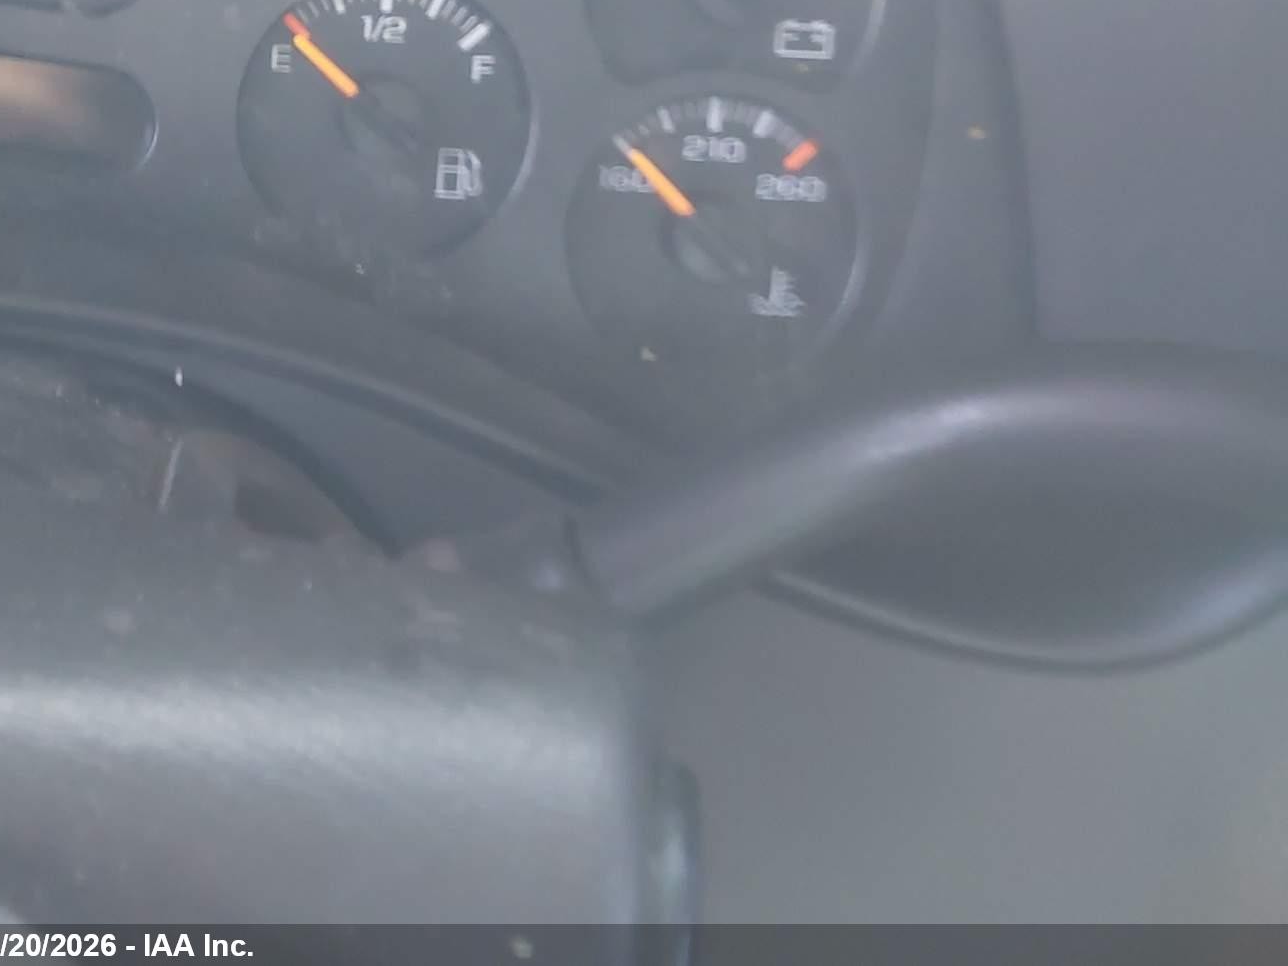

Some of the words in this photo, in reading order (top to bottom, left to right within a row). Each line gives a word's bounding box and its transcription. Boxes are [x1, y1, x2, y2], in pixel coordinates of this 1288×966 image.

[361, 15, 407, 44] 1/2
[271, 43, 292, 73] E
[470, 54, 496, 83] F
